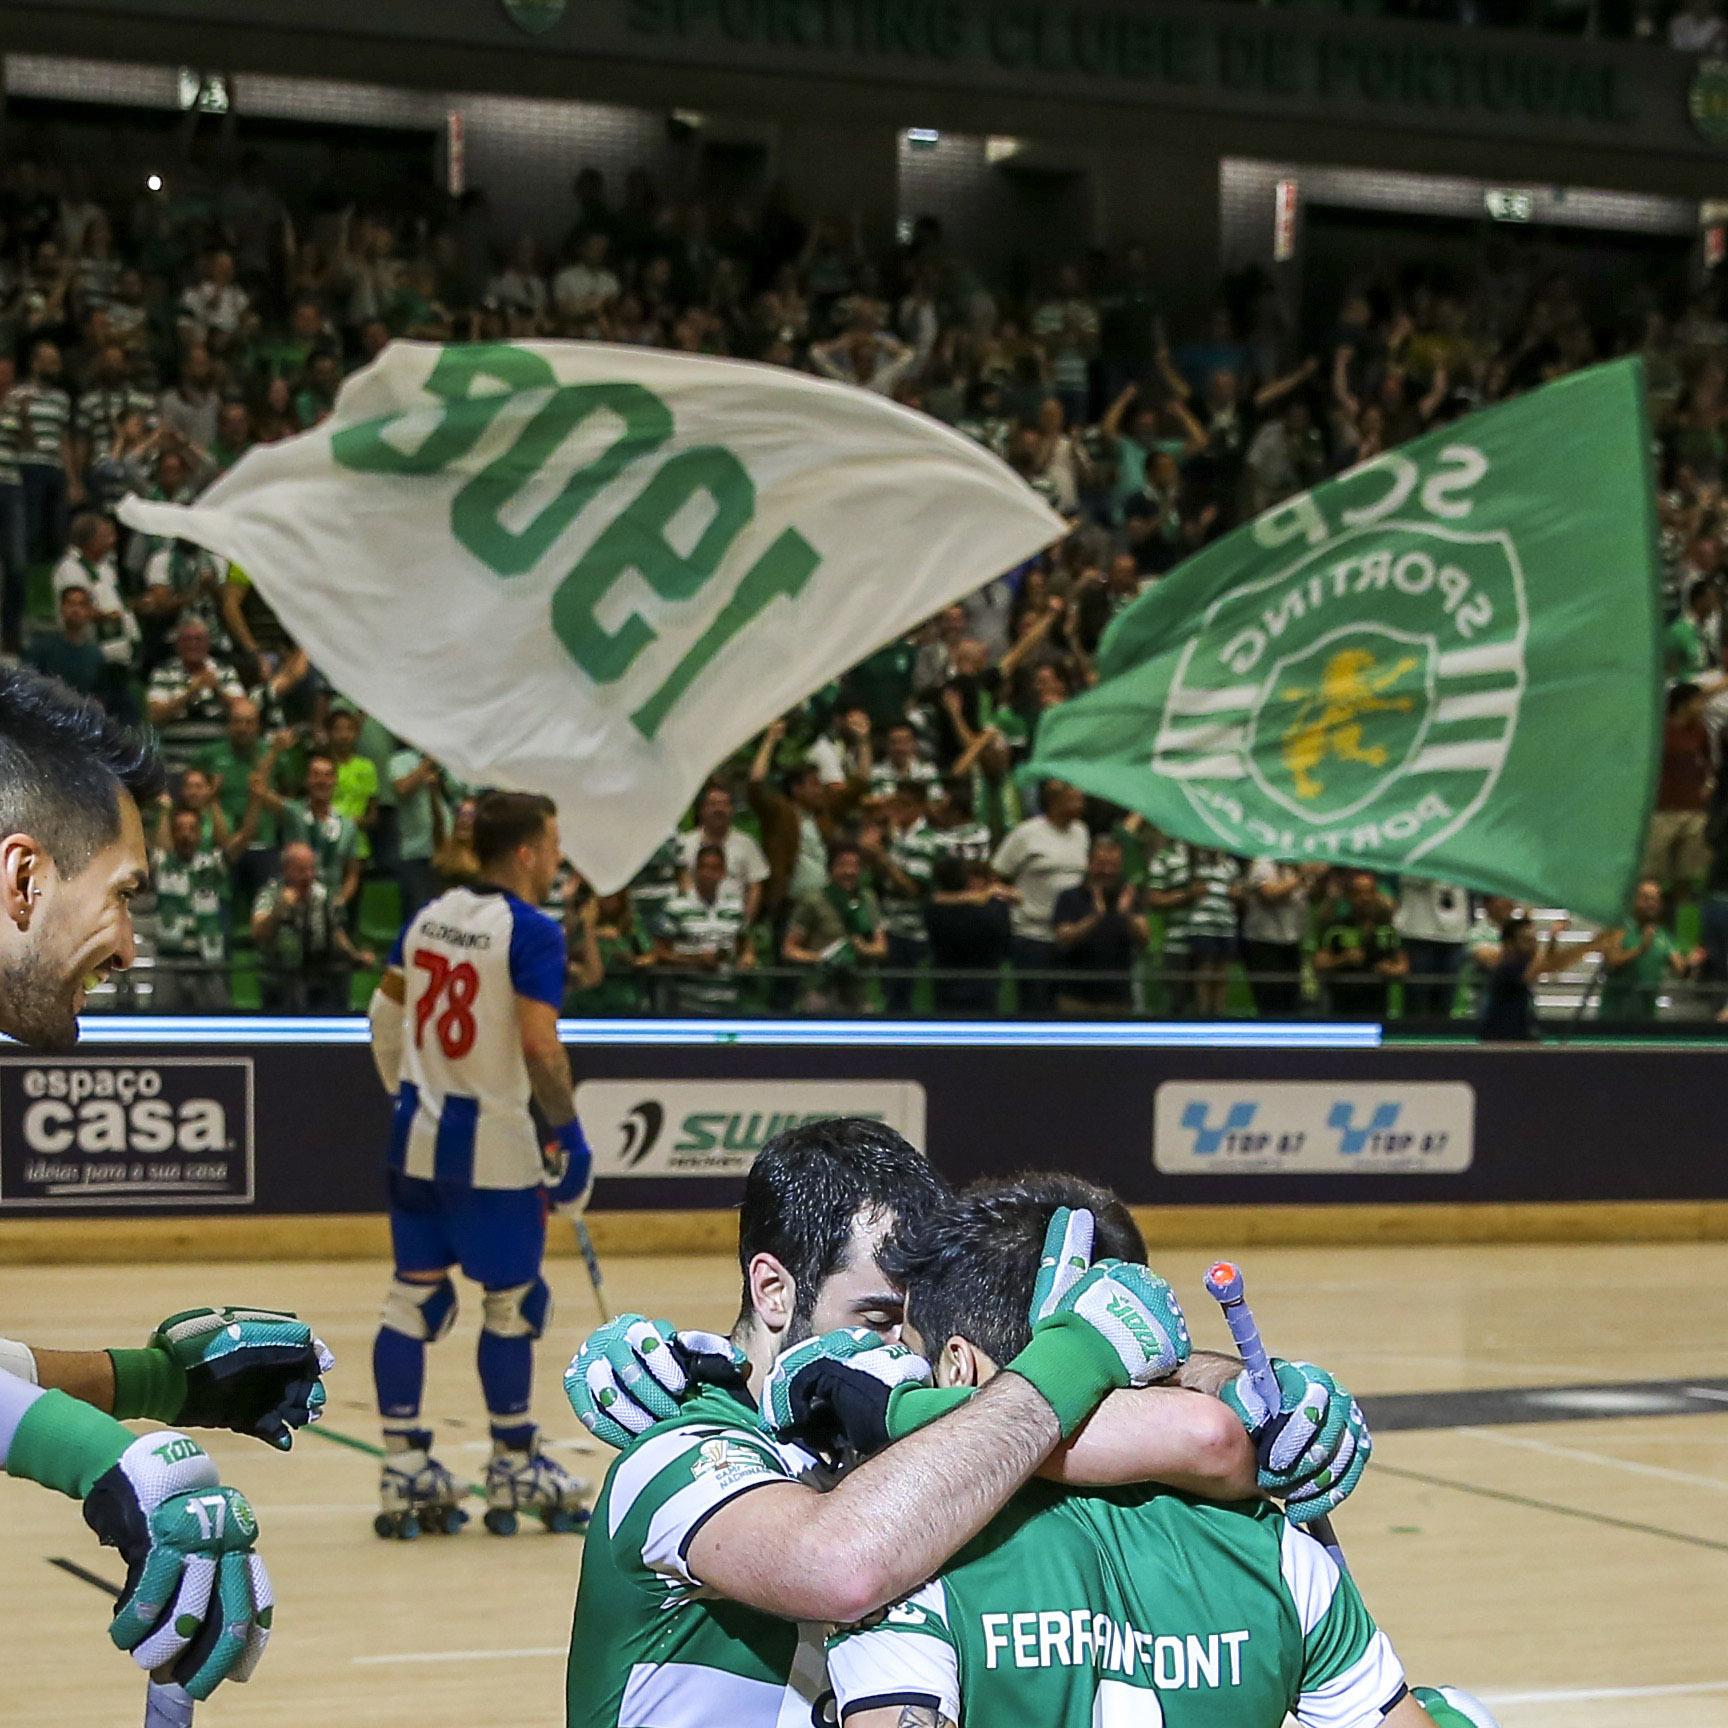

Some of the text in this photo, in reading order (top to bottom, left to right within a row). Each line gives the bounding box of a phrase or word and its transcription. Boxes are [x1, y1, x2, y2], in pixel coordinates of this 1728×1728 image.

[986, 6, 1202, 83] CLUBE
[1318, 38, 1638, 122] PORTUGAL
[414, 950, 479, 1060] 78
[23, 1068, 162, 1106] espaço
[24, 1098, 227, 1153] casa
[186, 1494, 226, 1540] 17
